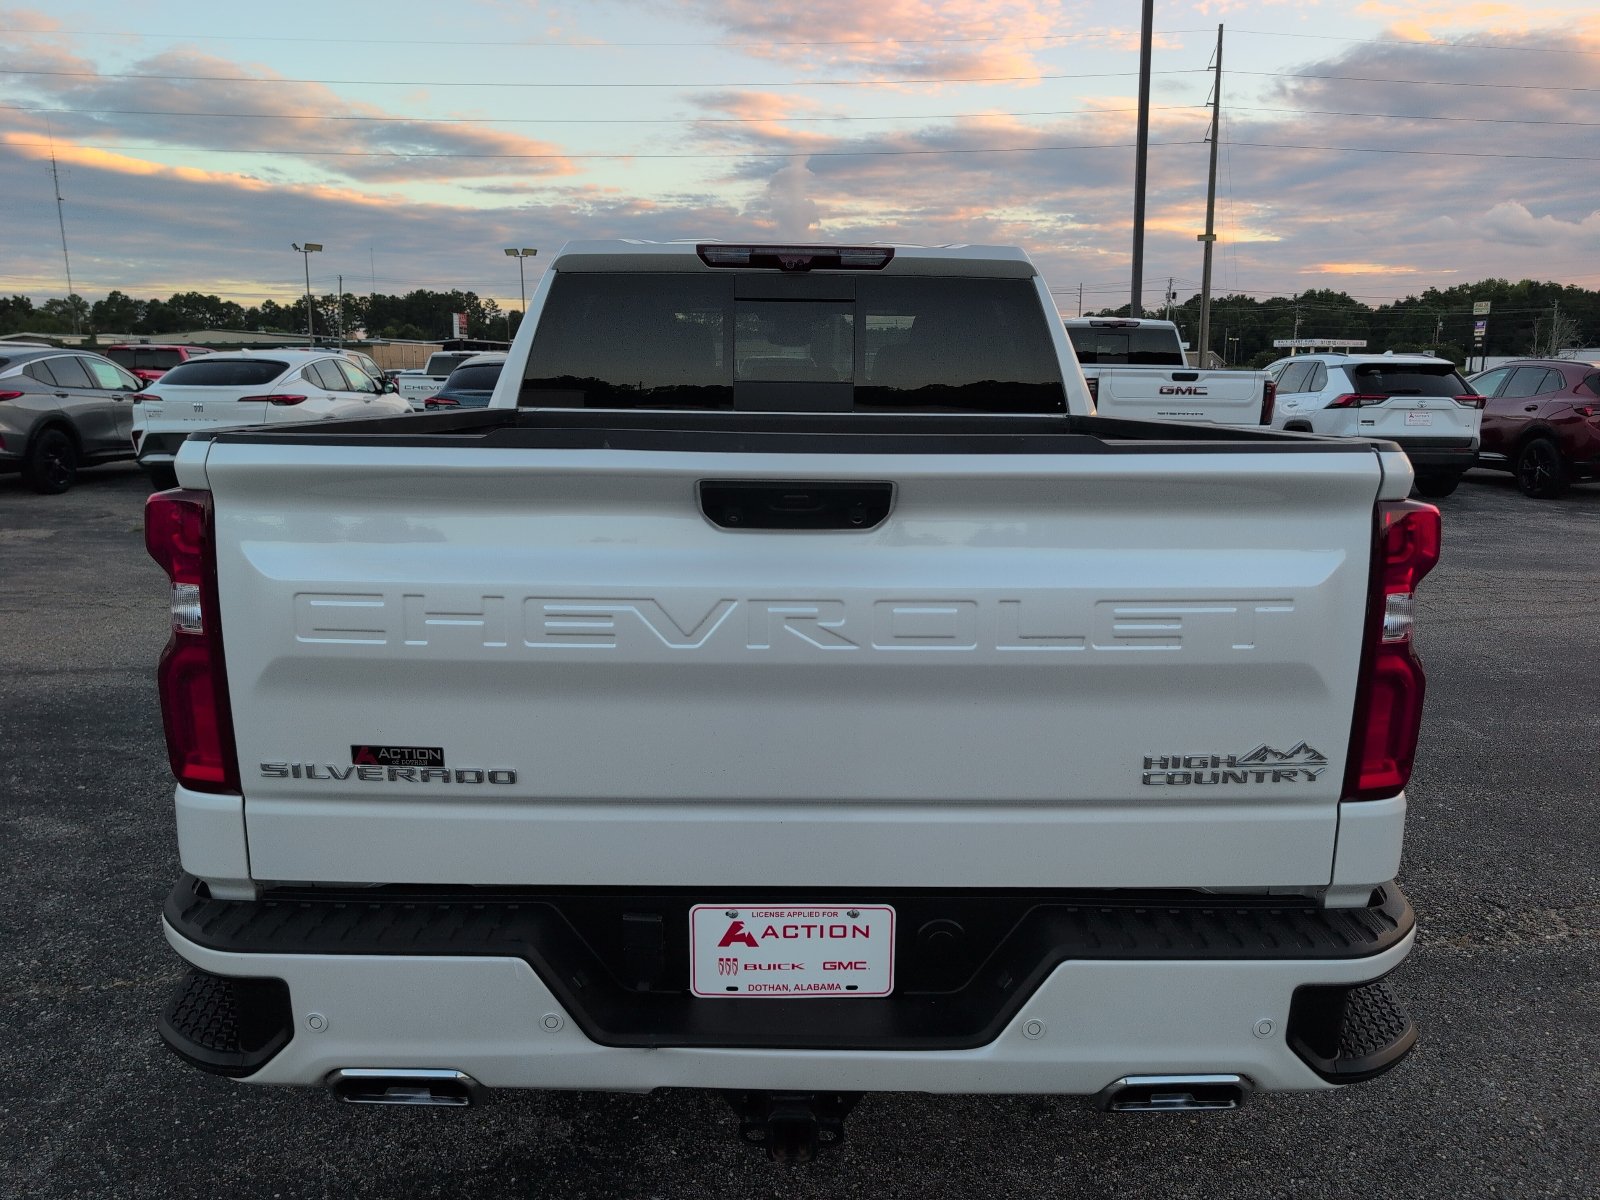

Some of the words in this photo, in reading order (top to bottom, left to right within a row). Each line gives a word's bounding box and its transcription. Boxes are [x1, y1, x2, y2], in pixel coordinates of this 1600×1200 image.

[1159, 386, 1208, 395] GMC
[293, 591, 1295, 651] CHEVROLET
[378, 748, 441, 759] ACTION
[1143, 754, 1237, 769] HIGH
[260, 762, 518, 785] SILVERADO
[1142, 767, 1326, 785] COUNTRY
[761, 925, 870, 939] ACTION
[743, 963, 805, 971] BUICK
[747, 984, 791, 992] DOTHAN,
[793, 983, 841, 991] ALABAMA
